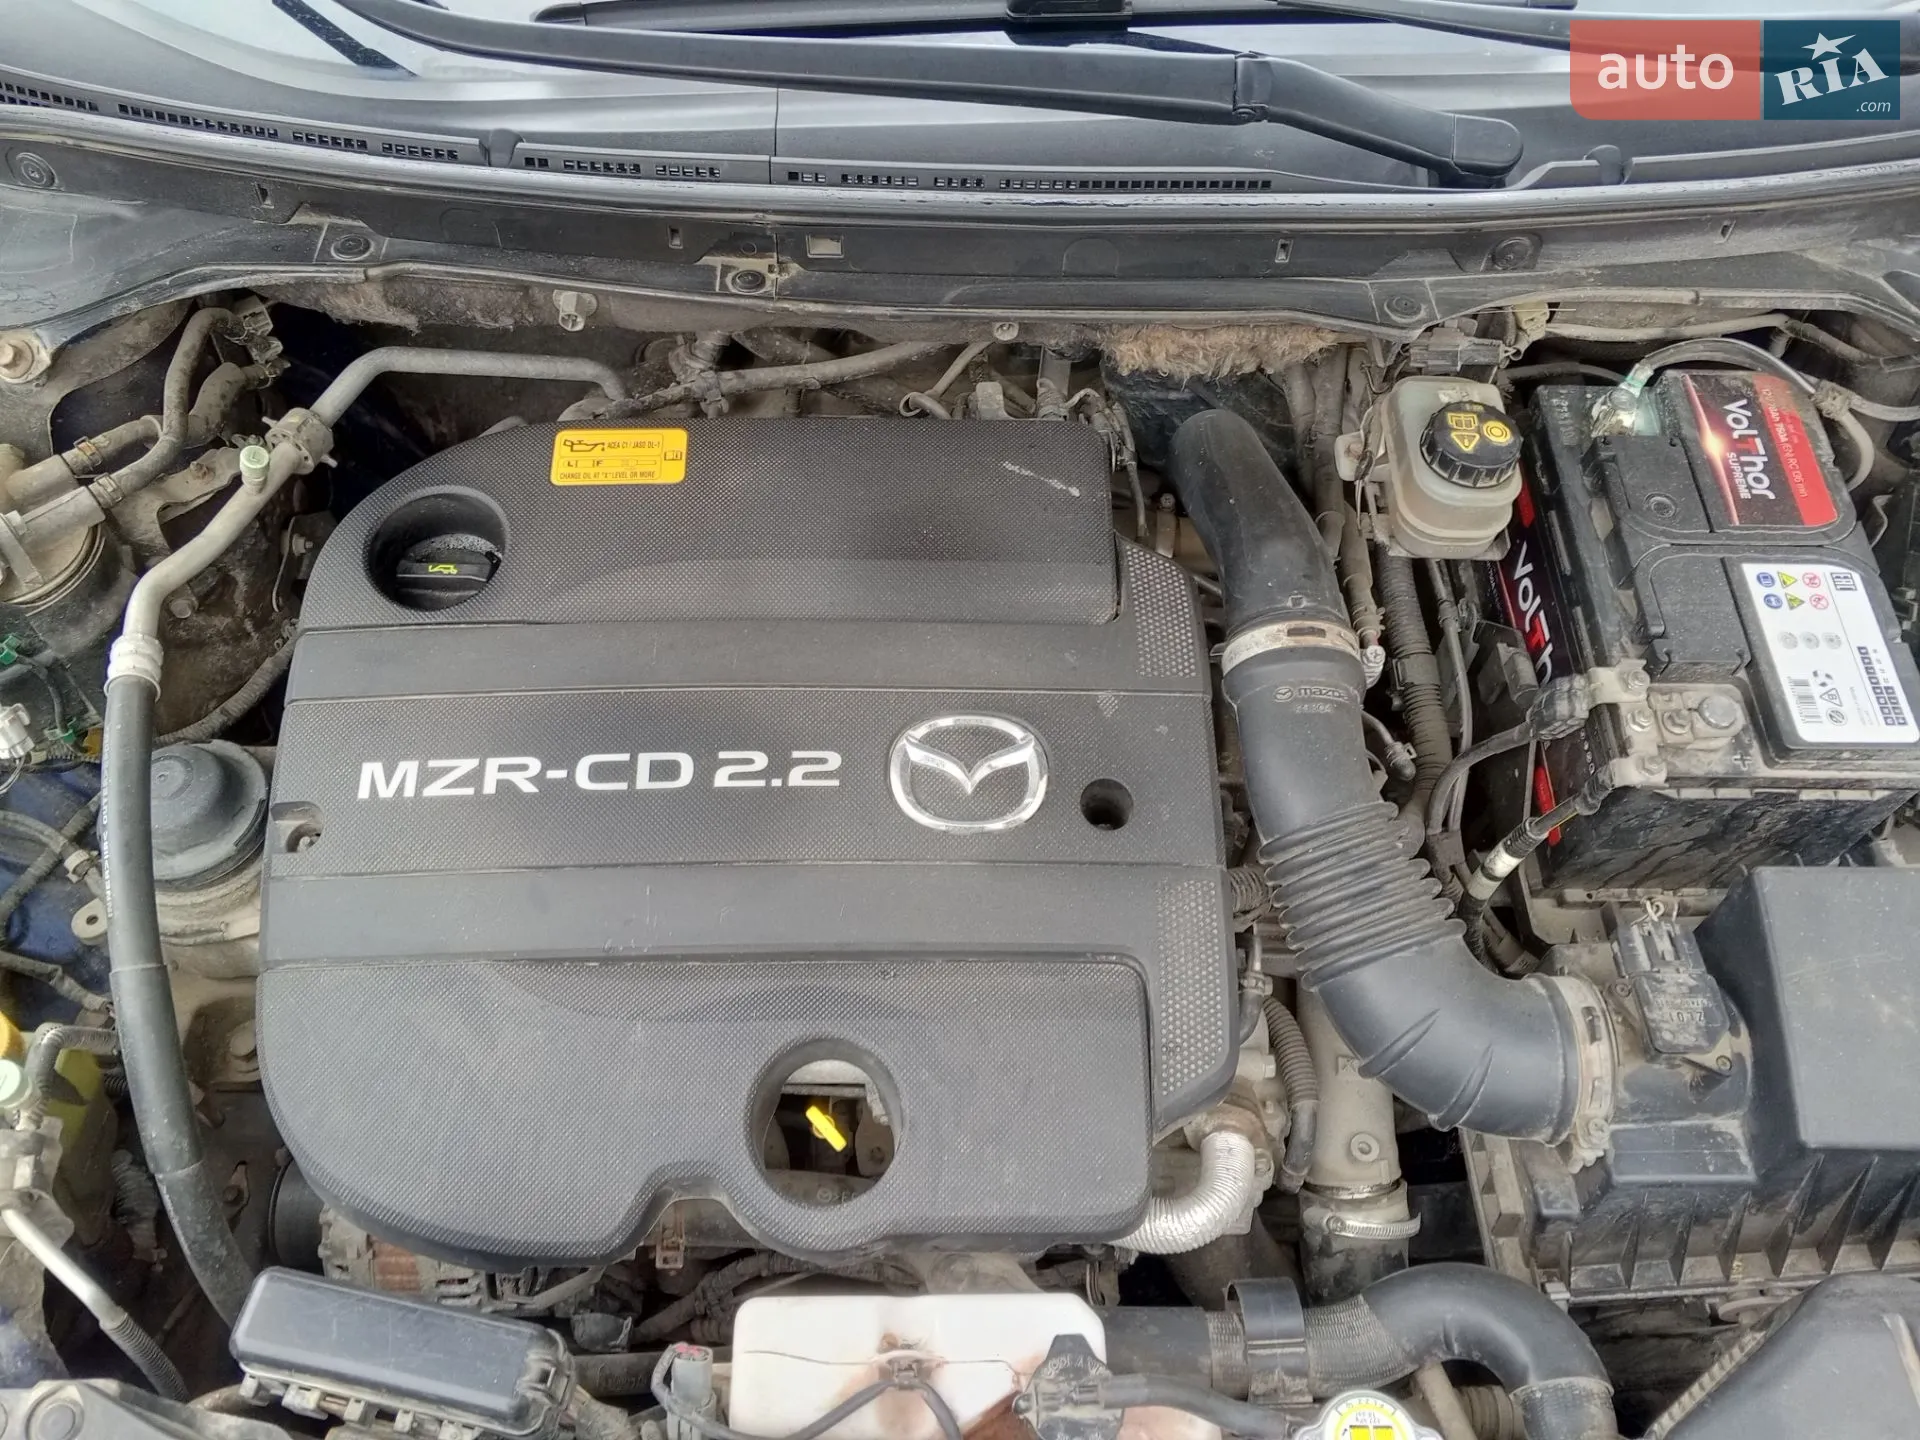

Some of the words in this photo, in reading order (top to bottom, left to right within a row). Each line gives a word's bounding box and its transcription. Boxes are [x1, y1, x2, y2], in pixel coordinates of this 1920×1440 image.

[559, 471, 582, 480] CHANGE
[582, 471, 592, 479] OIL
[592, 471, 601, 479] AT
[611, 471, 629, 479] LEVEL
[1726, 451, 1752, 500] SUPREME
[1513, 540, 1555, 688] VolTh
[356, 751, 695, 800] MZR-CD
[713, 750, 843, 789] 2.2
